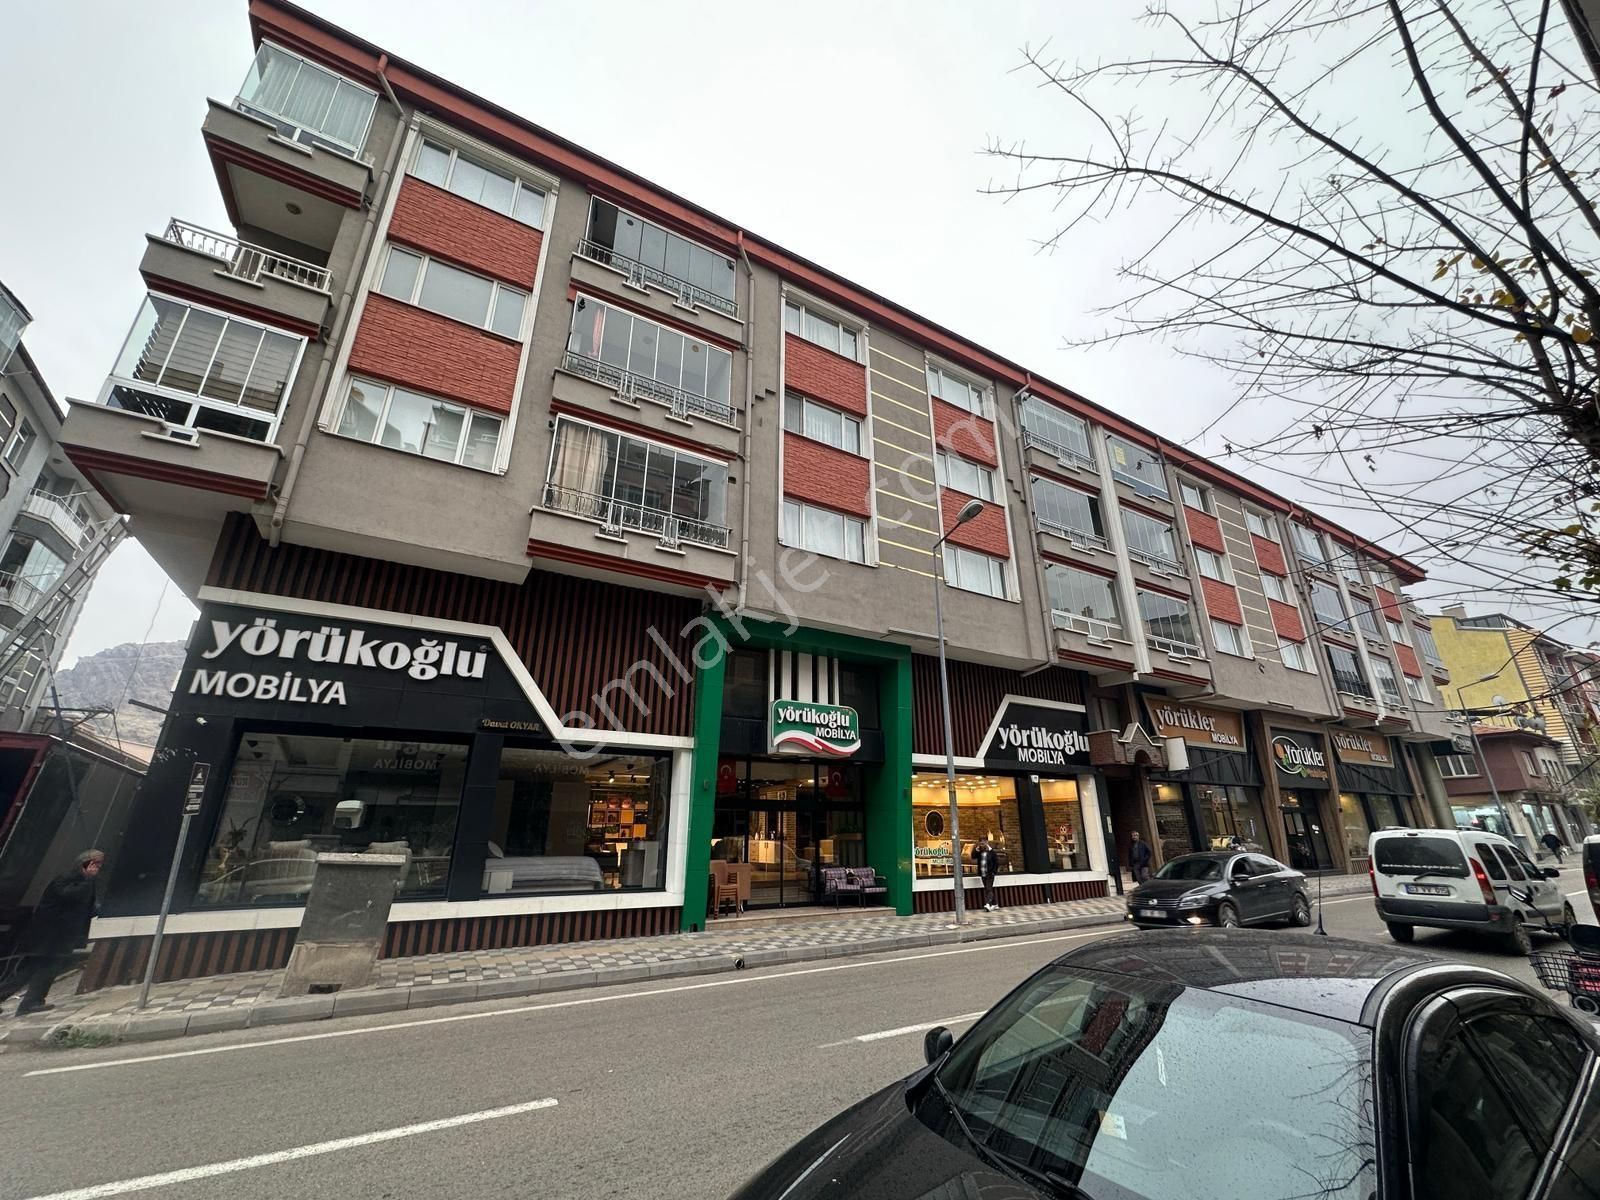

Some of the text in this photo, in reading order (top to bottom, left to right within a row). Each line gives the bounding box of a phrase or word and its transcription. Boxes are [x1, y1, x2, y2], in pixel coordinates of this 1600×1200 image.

[202, 617, 487, 681] yörükoğlu
[188, 670, 347, 706] MOBİLYA
[777, 706, 850, 729] yörükoğlu
[1155, 705, 1216, 732] yörükler
[815, 727, 857, 741] MOBİLYA
[998, 723, 1091, 756] yörükoğlu
[1283, 743, 1326, 768] Yörükler
